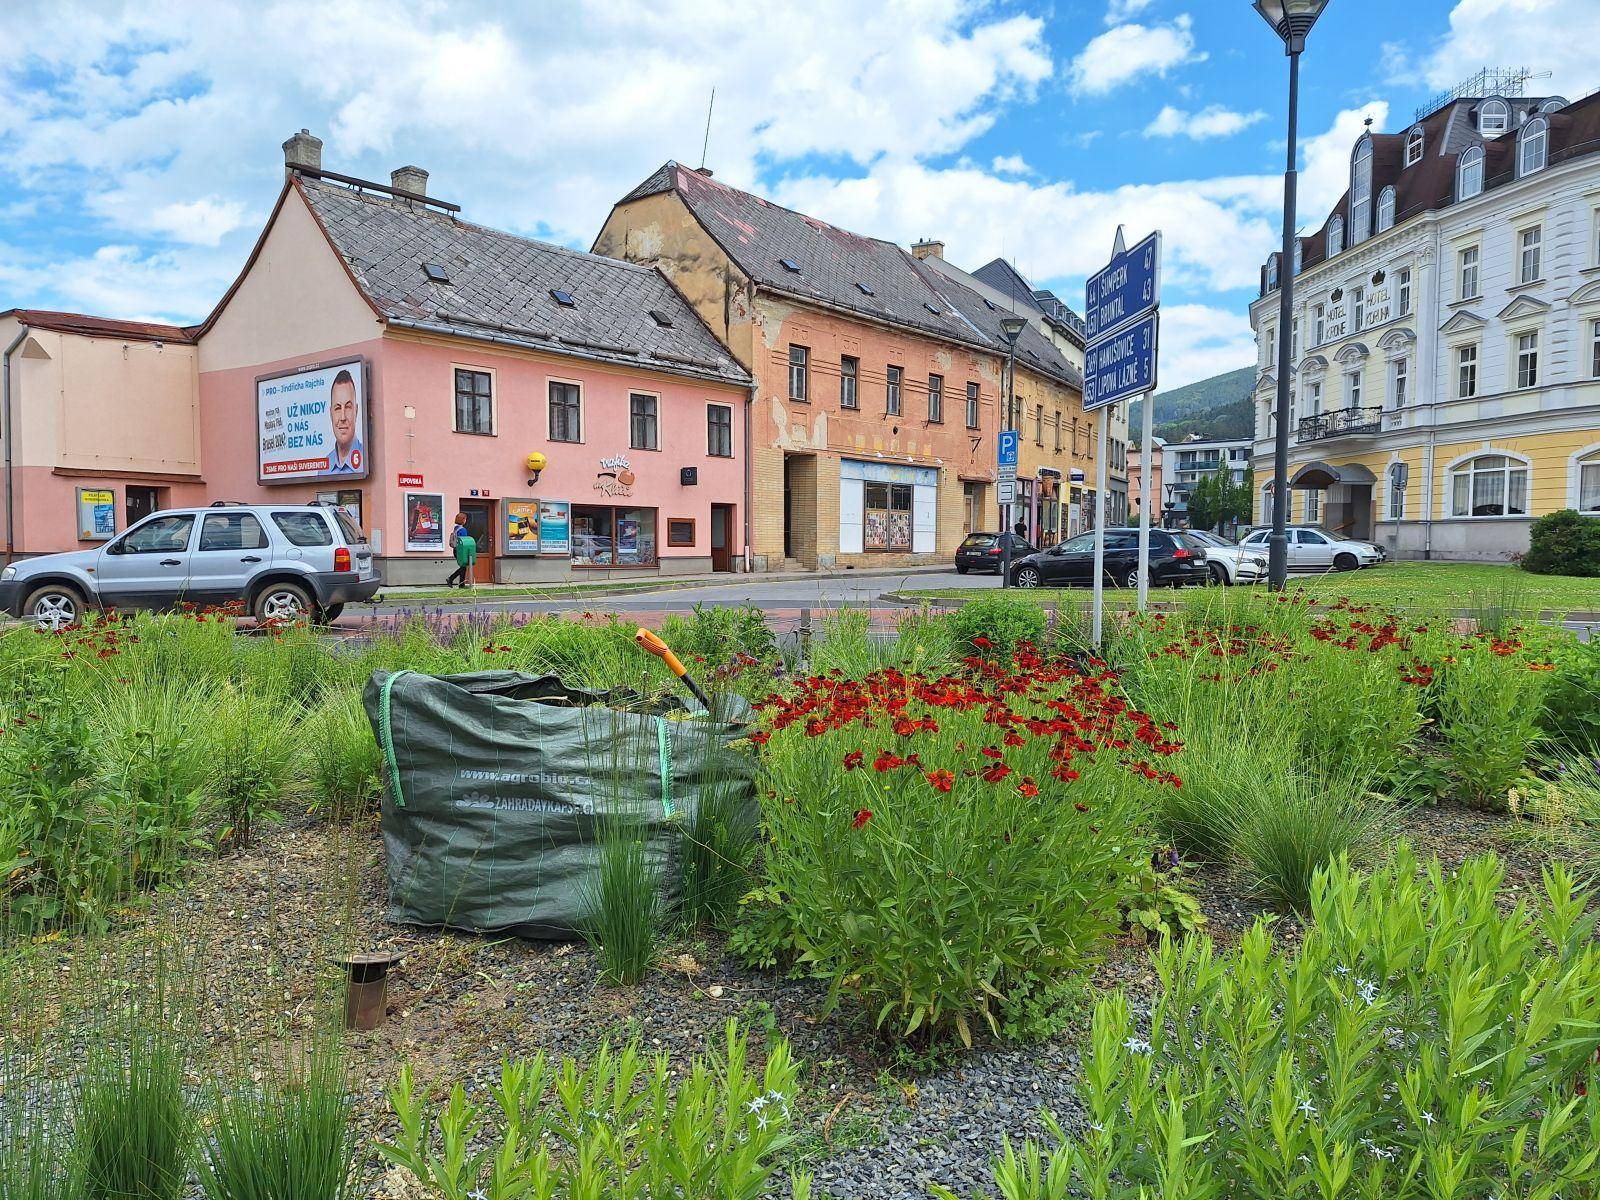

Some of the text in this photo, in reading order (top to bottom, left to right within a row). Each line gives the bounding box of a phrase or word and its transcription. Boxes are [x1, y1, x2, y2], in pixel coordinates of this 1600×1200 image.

[1089, 246, 1152, 305] 44 ŠUMPERK 47
[1101, 292, 1125, 327] BRUNTÁL
[1143, 277, 1151, 301] 43
[1367, 289, 1390, 307] HOTEL
[1327, 305, 1346, 322] HOTEL
[1099, 333, 1135, 369] HANUŠOVICE
[1143, 327, 1150, 350] 31
[1098, 366, 1117, 396] LIPOVÁ
[1118, 357, 1138, 388] LÁZNĚ
[1143, 357, 1149, 379] 5
[266, 386, 277, 396] PRO
[287, 403, 298, 418] UŽ
[300, 401, 326, 415] NIKDY
[287, 419, 309, 432] O NÁS
[287, 430, 323, 449] BEZ NÁS
[1002, 435, 1014, 454] P
[353, 453, 359, 464] 6
[278, 464, 287, 472] PRO
